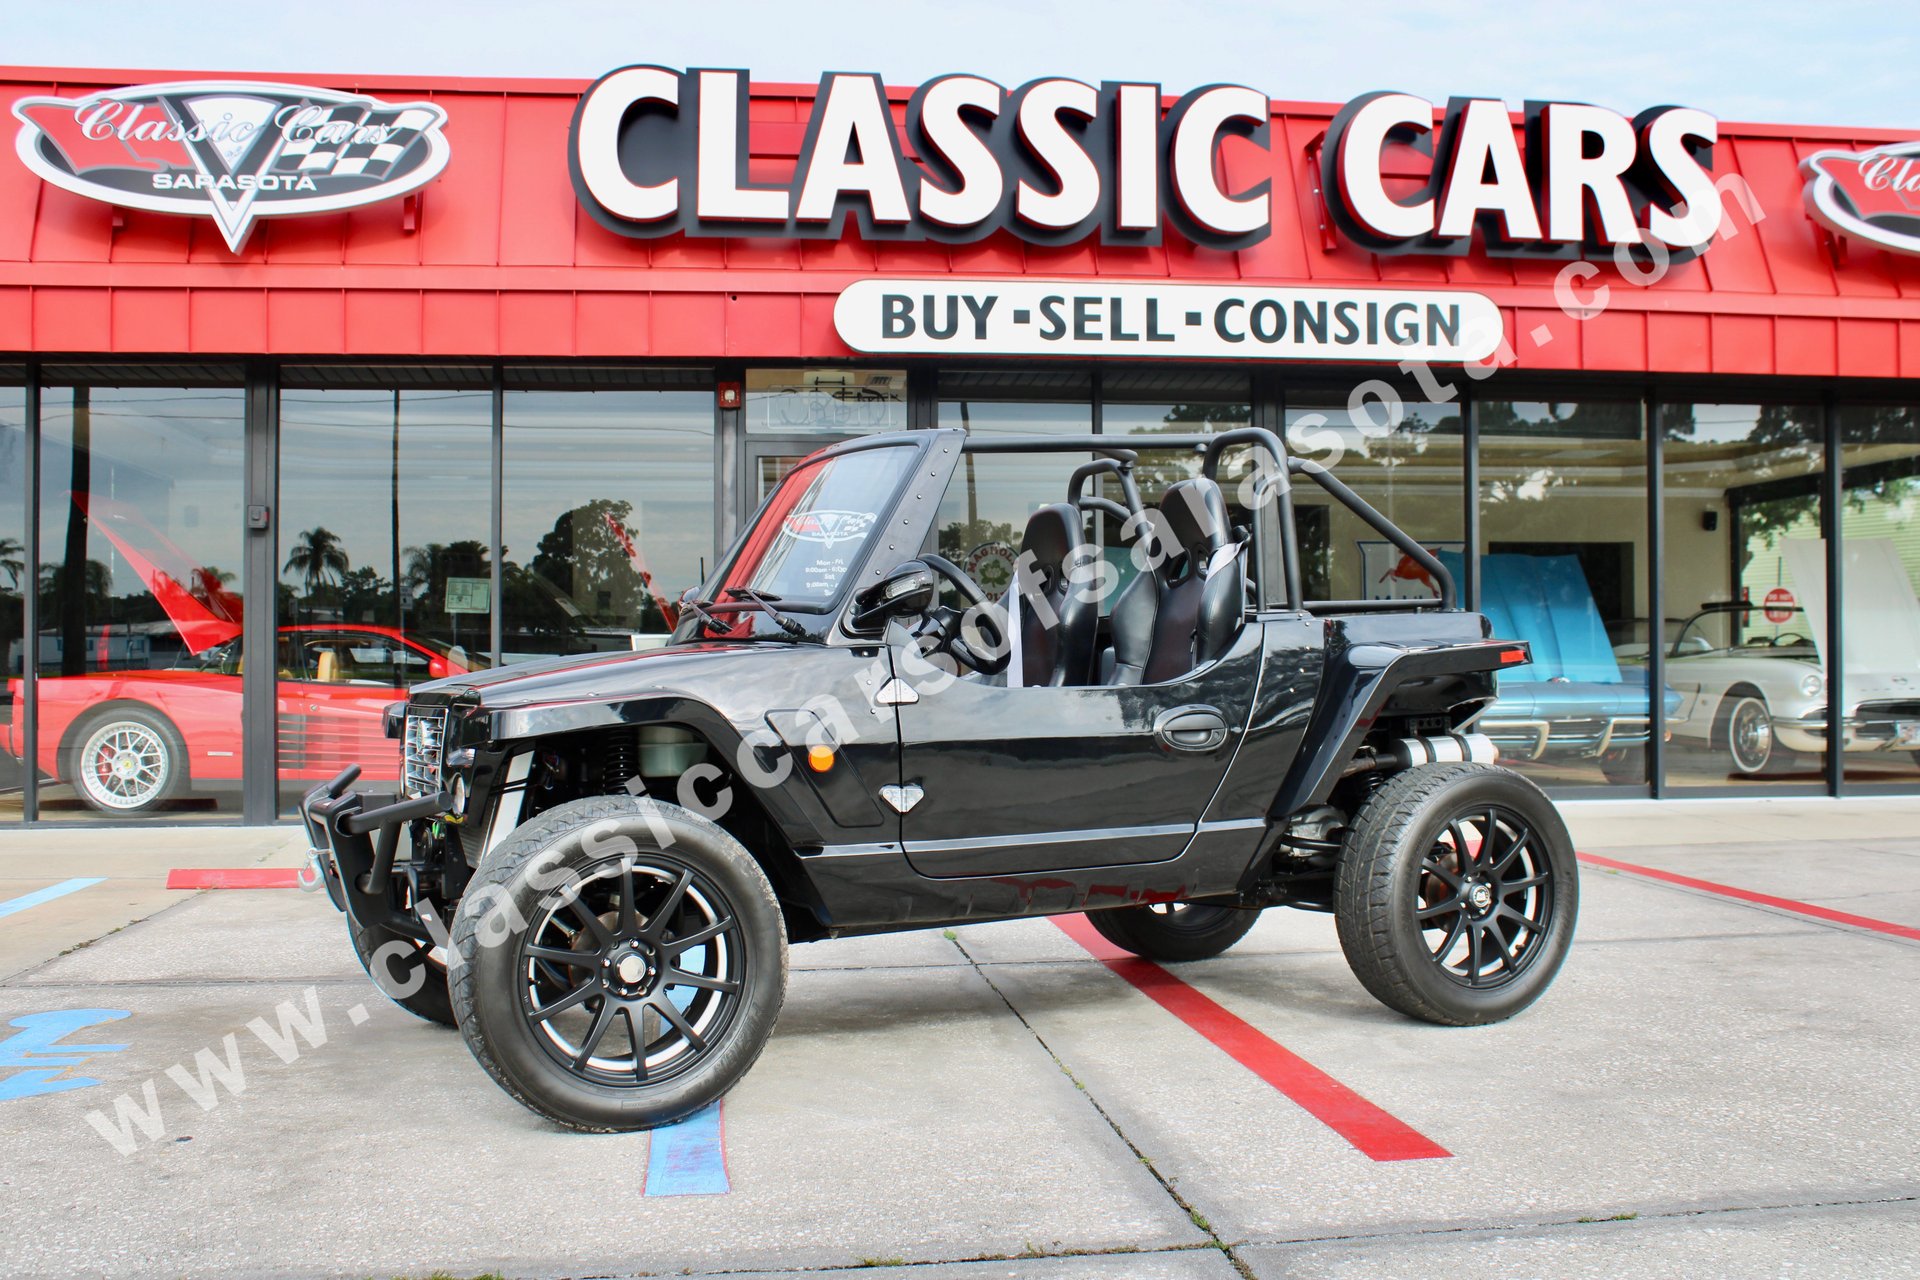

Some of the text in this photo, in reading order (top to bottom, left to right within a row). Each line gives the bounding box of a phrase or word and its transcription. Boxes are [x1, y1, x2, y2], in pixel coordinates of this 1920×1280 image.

[73, 98, 401, 145] Classic Cars
[574, 65, 1722, 248] CLASSIC CARS
[152, 173, 317, 191] SARASOTA
[881, 293, 1461, 348] BUY SELL CONSIGN
[967, 545, 1015, 573] MAGNOL
